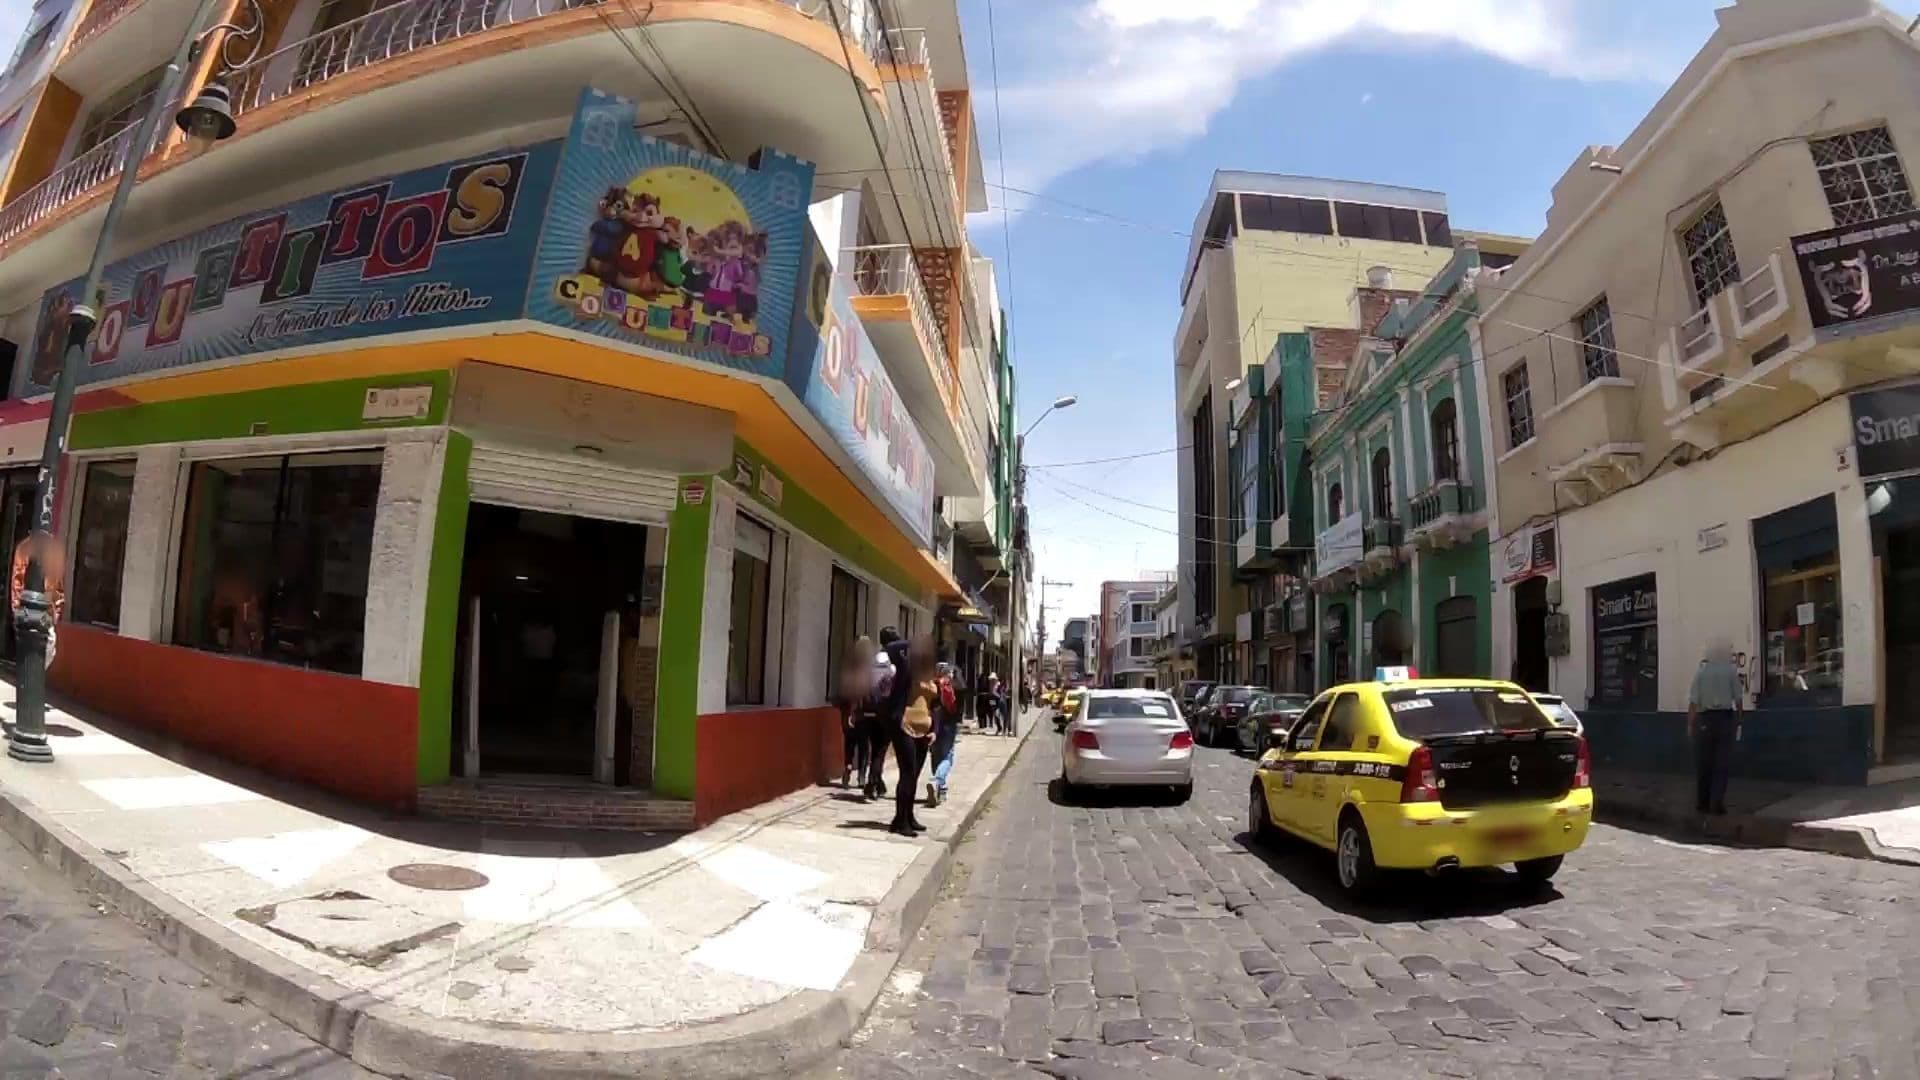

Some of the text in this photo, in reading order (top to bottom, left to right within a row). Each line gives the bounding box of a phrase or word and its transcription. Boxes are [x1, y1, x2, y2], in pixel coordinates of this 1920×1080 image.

[92, 163, 512, 354] OQUETITOS
[360, 290, 395, 323] los
[1599, 594, 1633, 617] Smart
